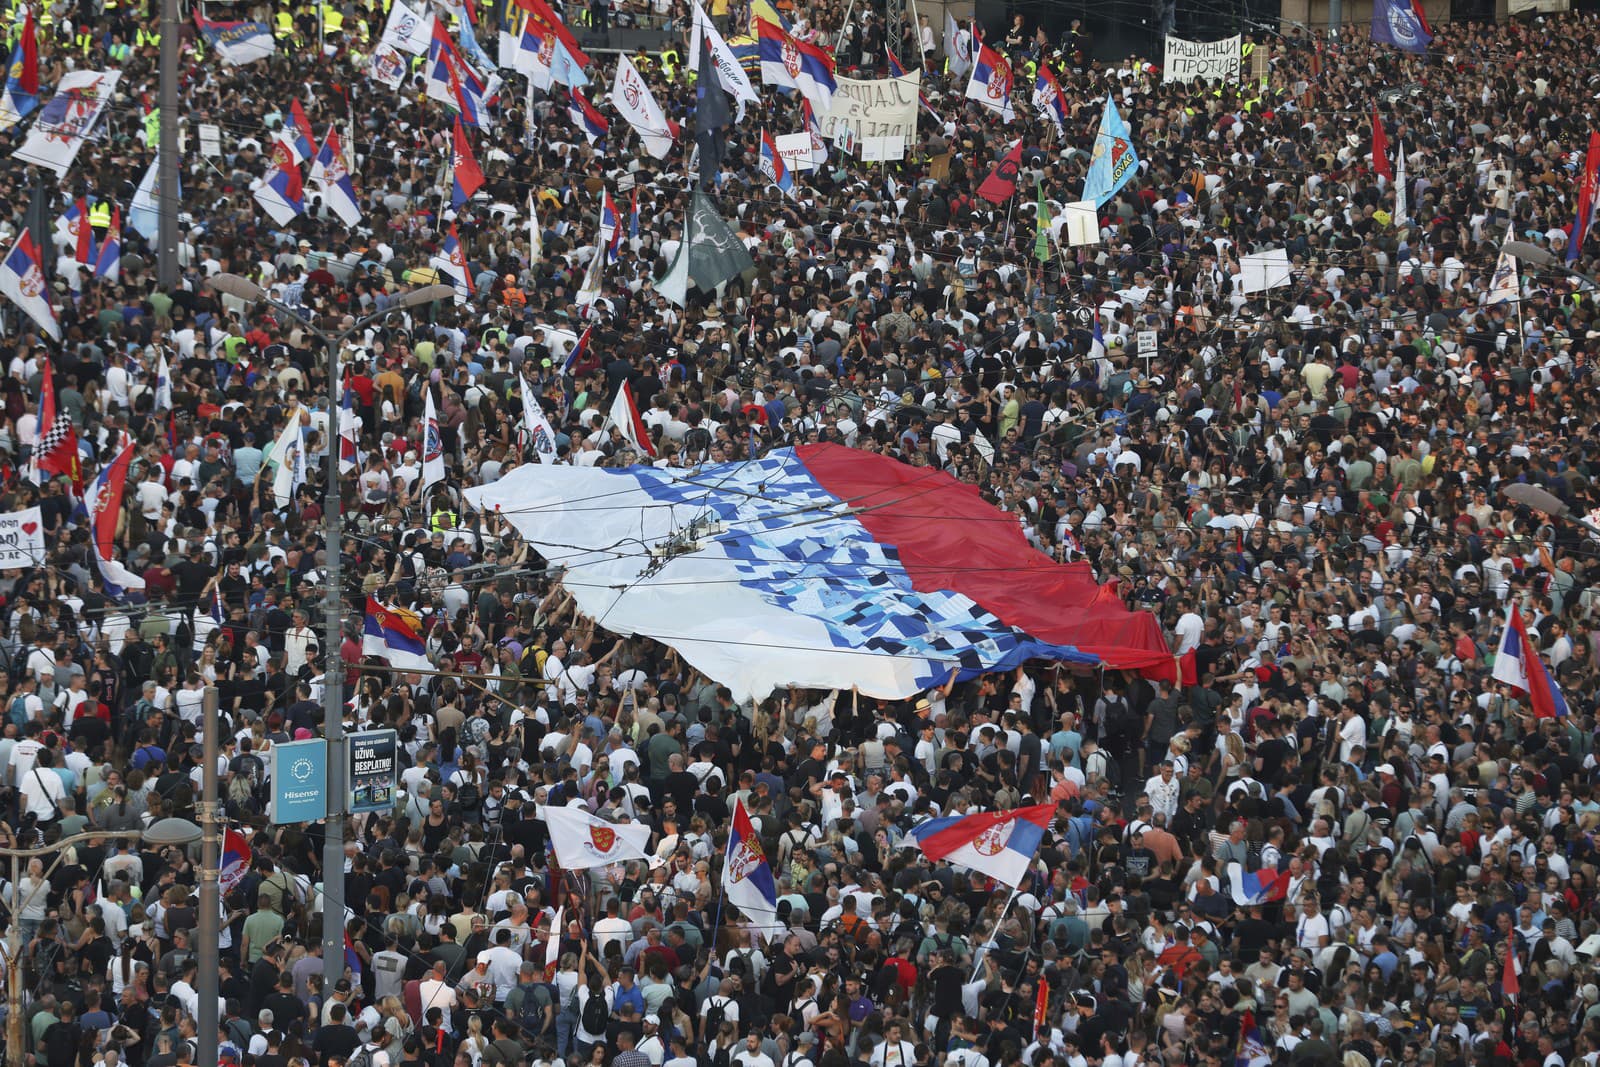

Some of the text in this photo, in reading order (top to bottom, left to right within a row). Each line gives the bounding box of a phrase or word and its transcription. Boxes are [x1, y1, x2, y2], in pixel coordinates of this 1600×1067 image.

[1168, 41, 1236, 57] МАШИНЦИ
[1173, 57, 1238, 73] ПРОТИВ
[354, 747, 376, 759] UŽIVO,
[354, 757, 392, 771] BESPLATNO!
[284, 789, 319, 799] Hisense
